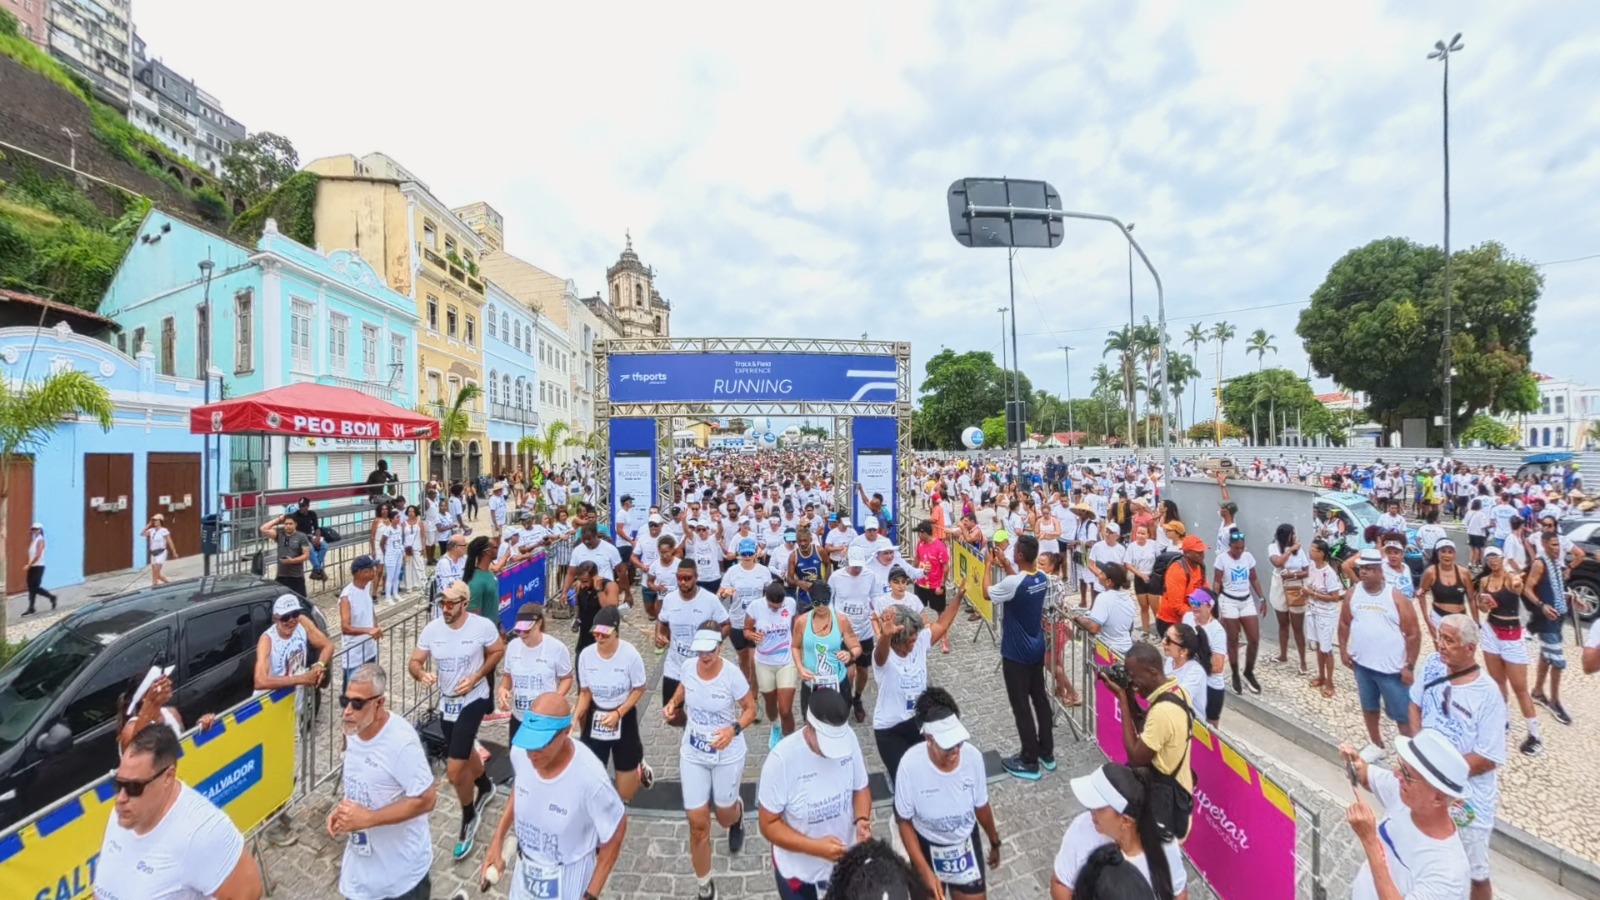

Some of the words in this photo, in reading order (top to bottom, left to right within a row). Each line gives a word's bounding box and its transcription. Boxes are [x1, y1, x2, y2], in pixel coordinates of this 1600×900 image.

[632, 372, 667, 384] tfsports
[714, 379, 793, 394] RUNNING
[294, 415, 335, 434] PEO
[341, 420, 380, 436] BOM
[392, 423, 405, 437] 01
[524, 577, 540, 595] MP3
[693, 739, 712, 752] 706
[1193, 786, 1249, 849] uperar
[941, 857, 967, 872] 310
[527, 879, 549, 899] 741
